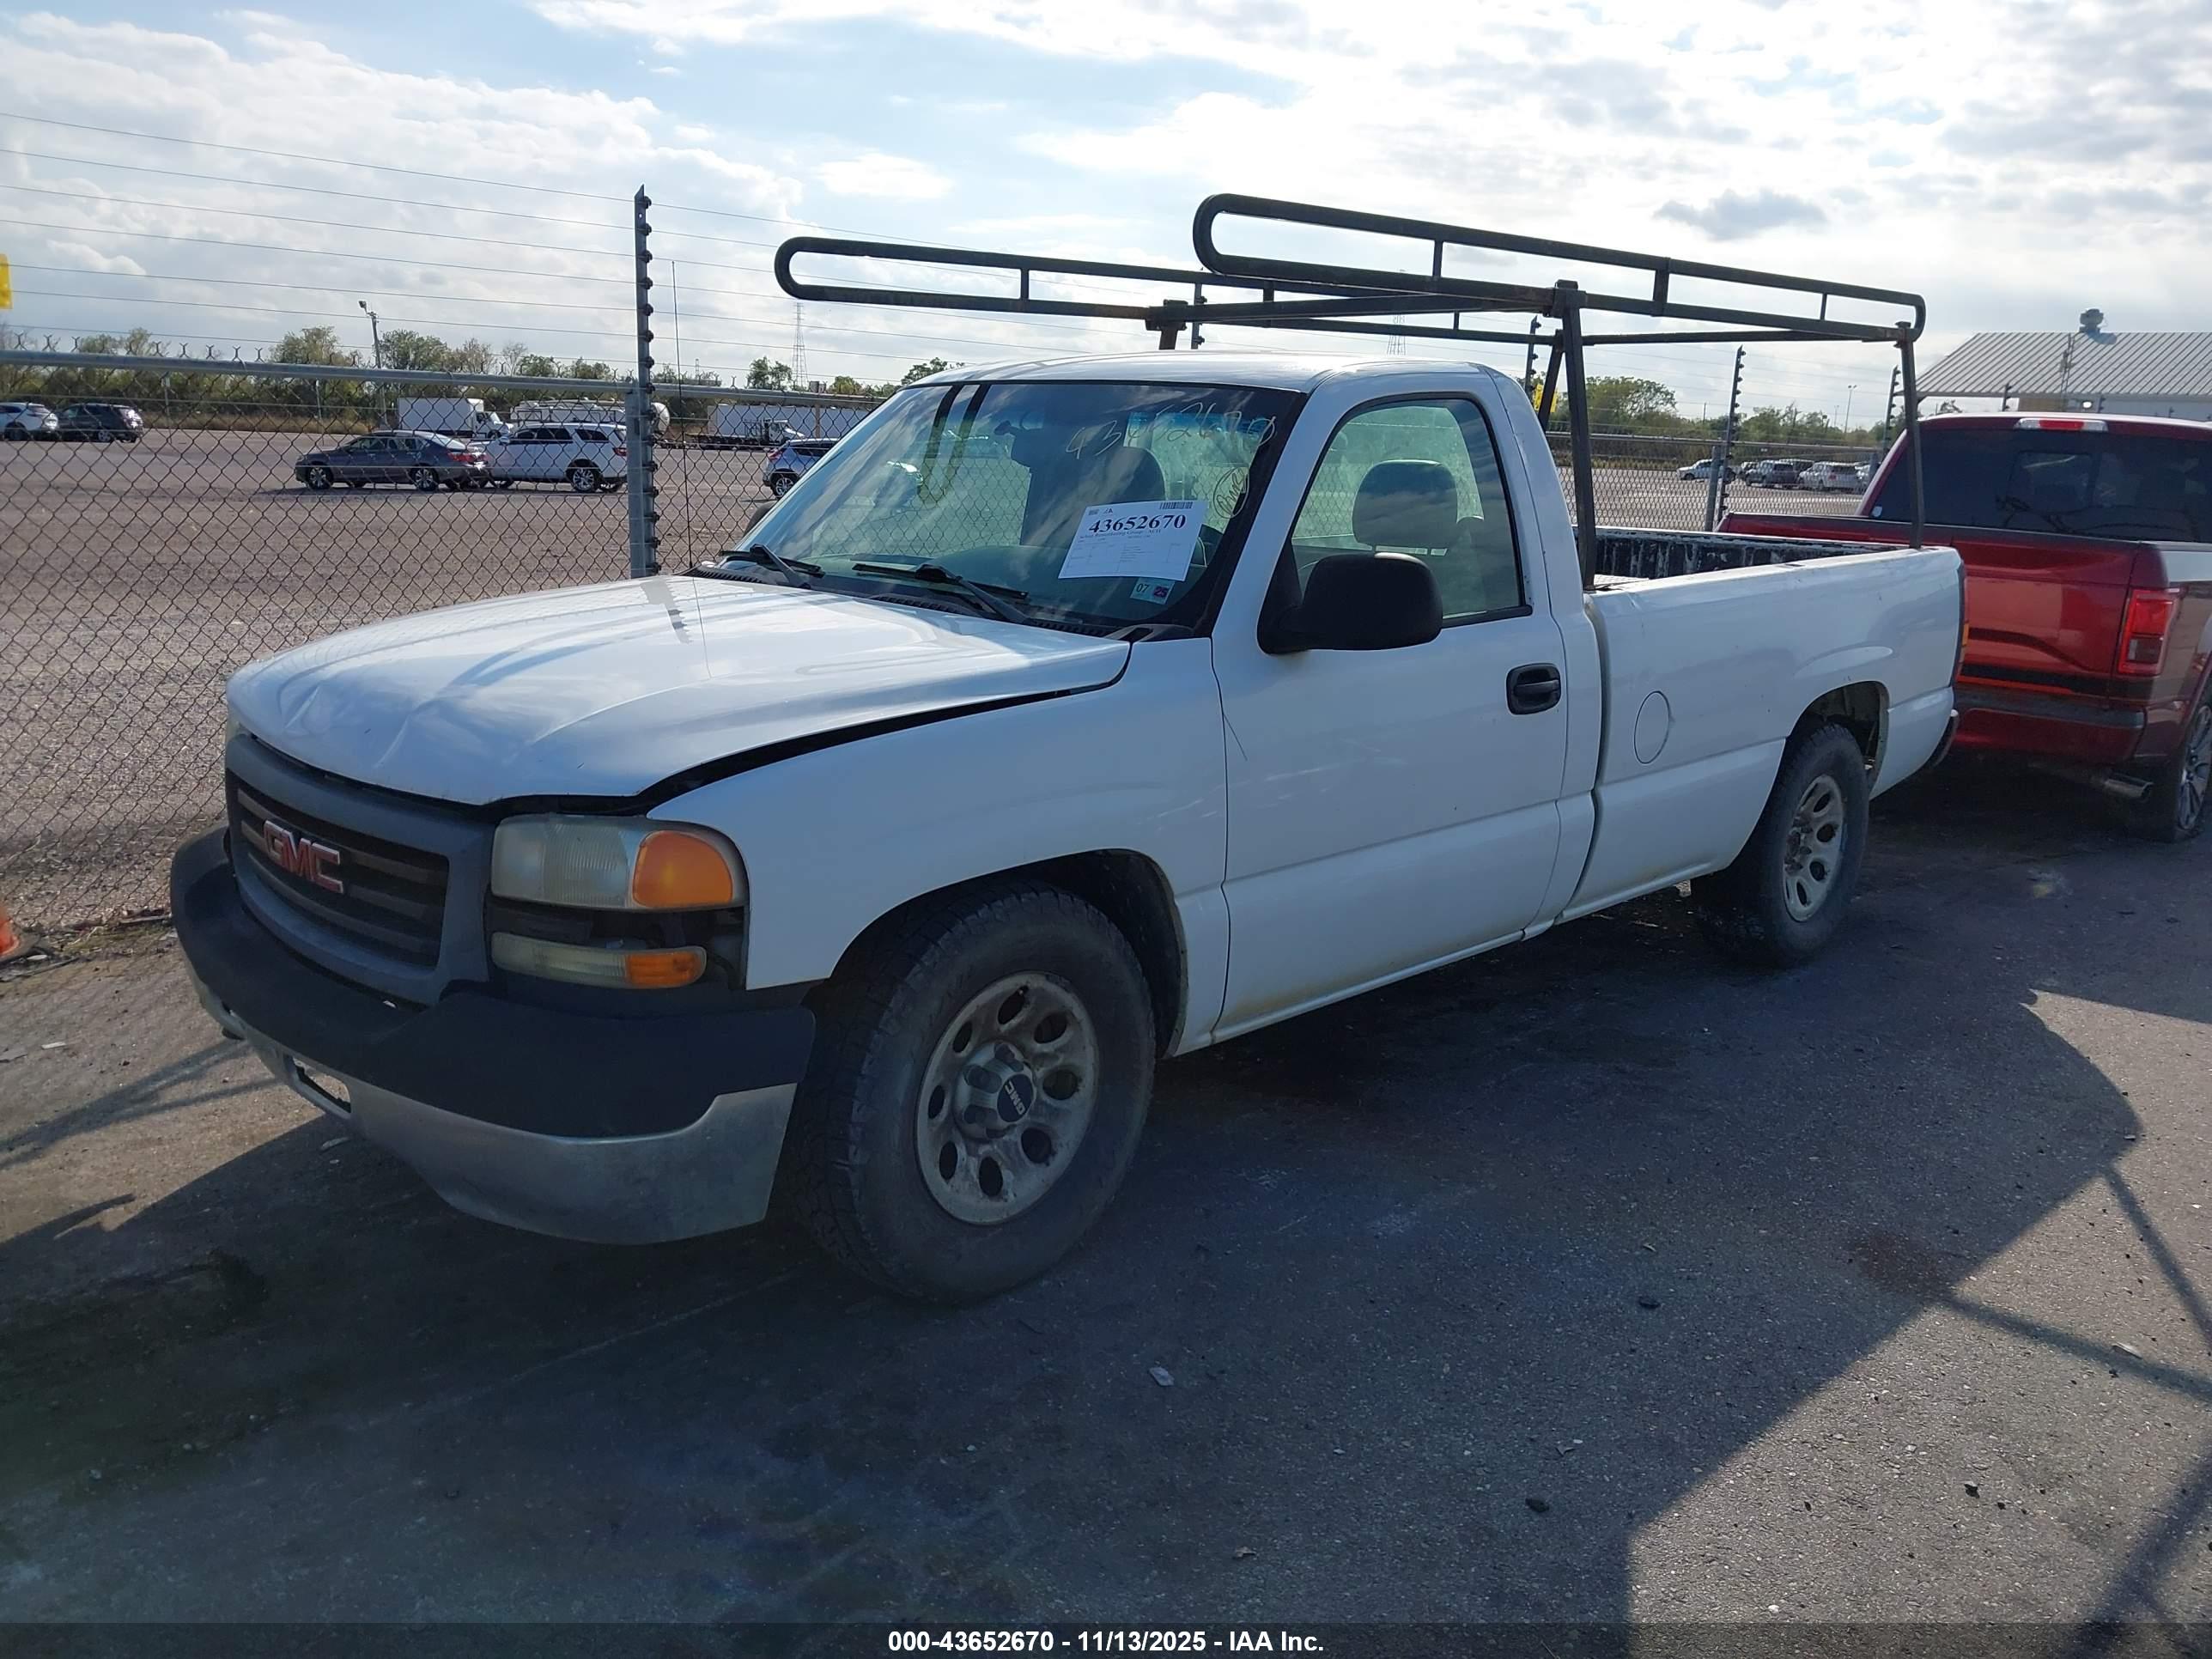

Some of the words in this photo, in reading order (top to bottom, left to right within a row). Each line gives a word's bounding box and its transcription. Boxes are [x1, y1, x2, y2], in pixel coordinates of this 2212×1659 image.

[1089, 514, 1187, 533] 43652670
[1136, 583, 1149, 592] 07
[263, 820, 343, 894] GMC
[1005, 1080, 1026, 1115] GMC
